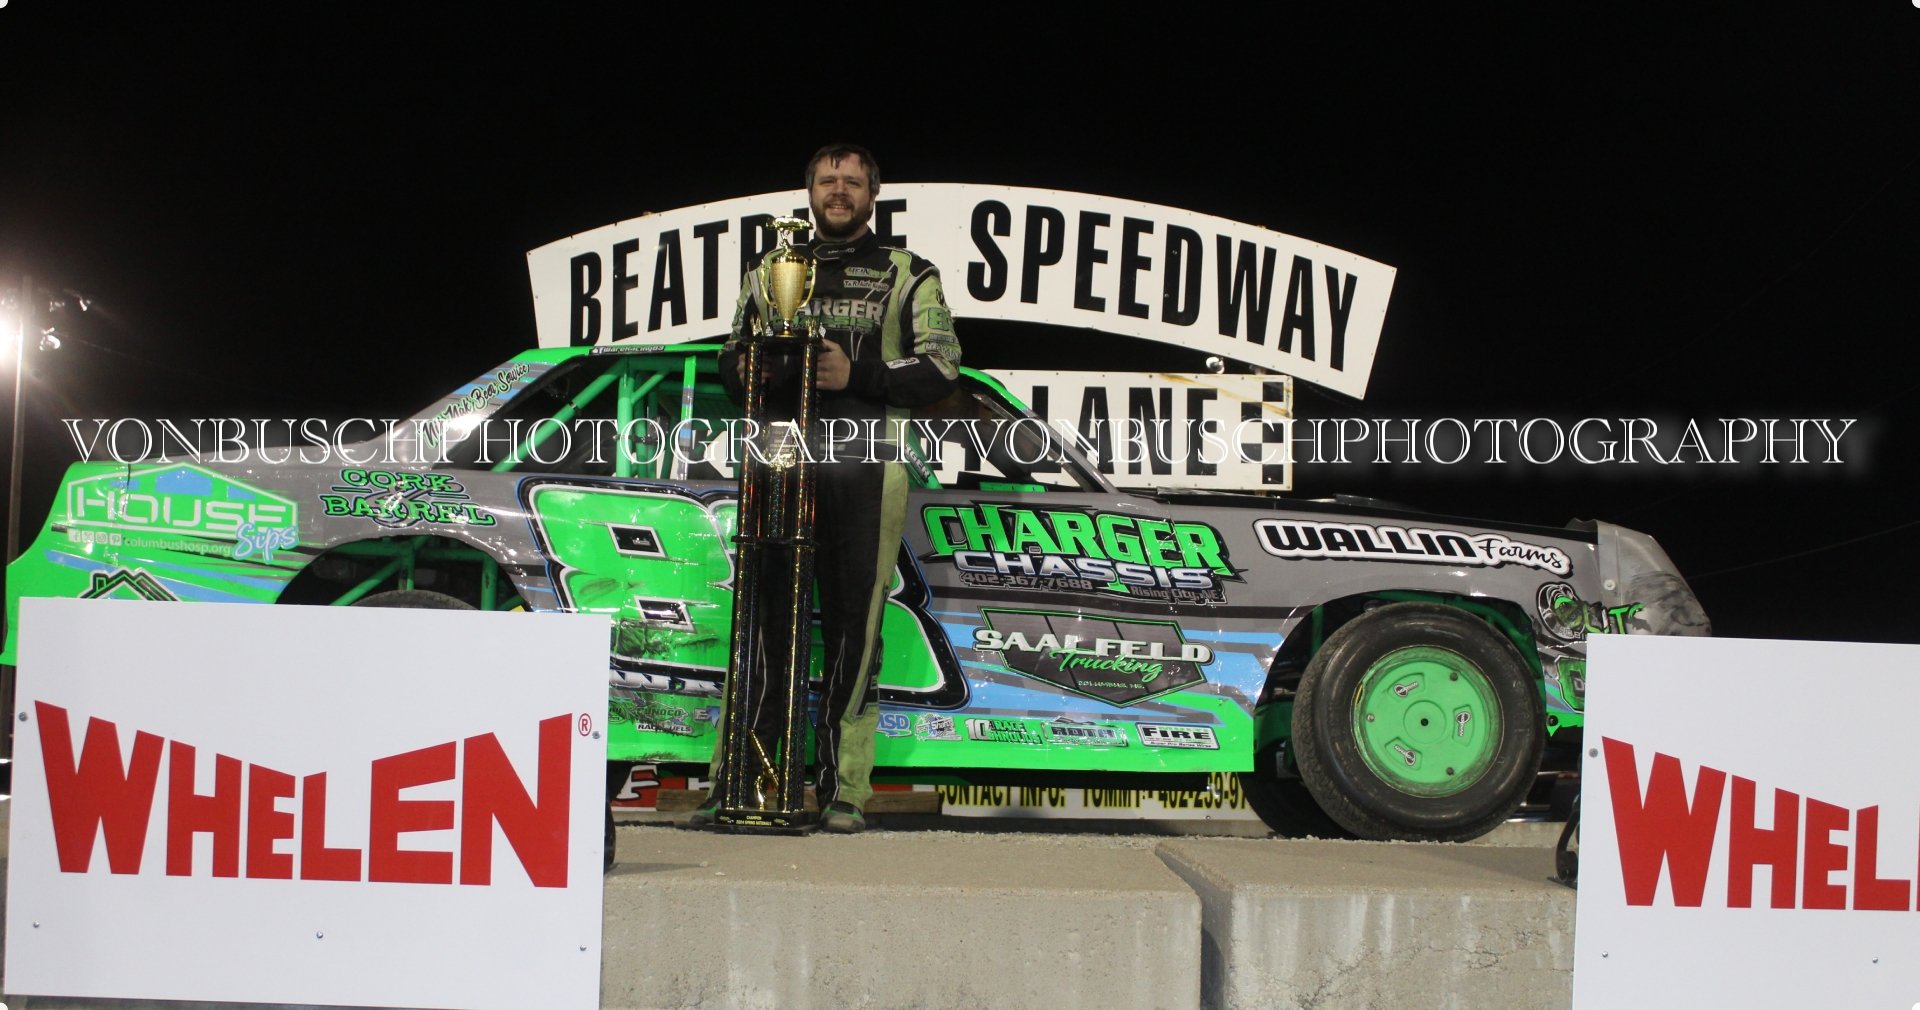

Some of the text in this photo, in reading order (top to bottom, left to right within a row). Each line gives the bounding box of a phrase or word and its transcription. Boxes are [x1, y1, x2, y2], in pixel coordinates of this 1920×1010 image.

[571, 197, 1357, 372] BEATRE SPEEDWAY
[1032, 385, 1218, 476] LANE
[341, 469, 455, 493] CORK
[77, 486, 287, 533] HOUSE
[321, 495, 496, 526] BARREL
[124, 536, 232, 557] columbushosp.org
[233, 522, 298, 564] Sips
[922, 503, 1236, 578] CHARGER
[1262, 525, 1562, 569] WALLIN Farms
[953, 550, 1213, 589] CHASSIS
[1130, 585, 1169, 601] Rising
[973, 629, 1213, 664] SAALFELD
[1050, 650, 1163, 684] Trucking
[1142, 727, 1212, 740] FIRE
[35, 700, 573, 888] WHELEN
[1601, 735, 1920, 912] WHEL
